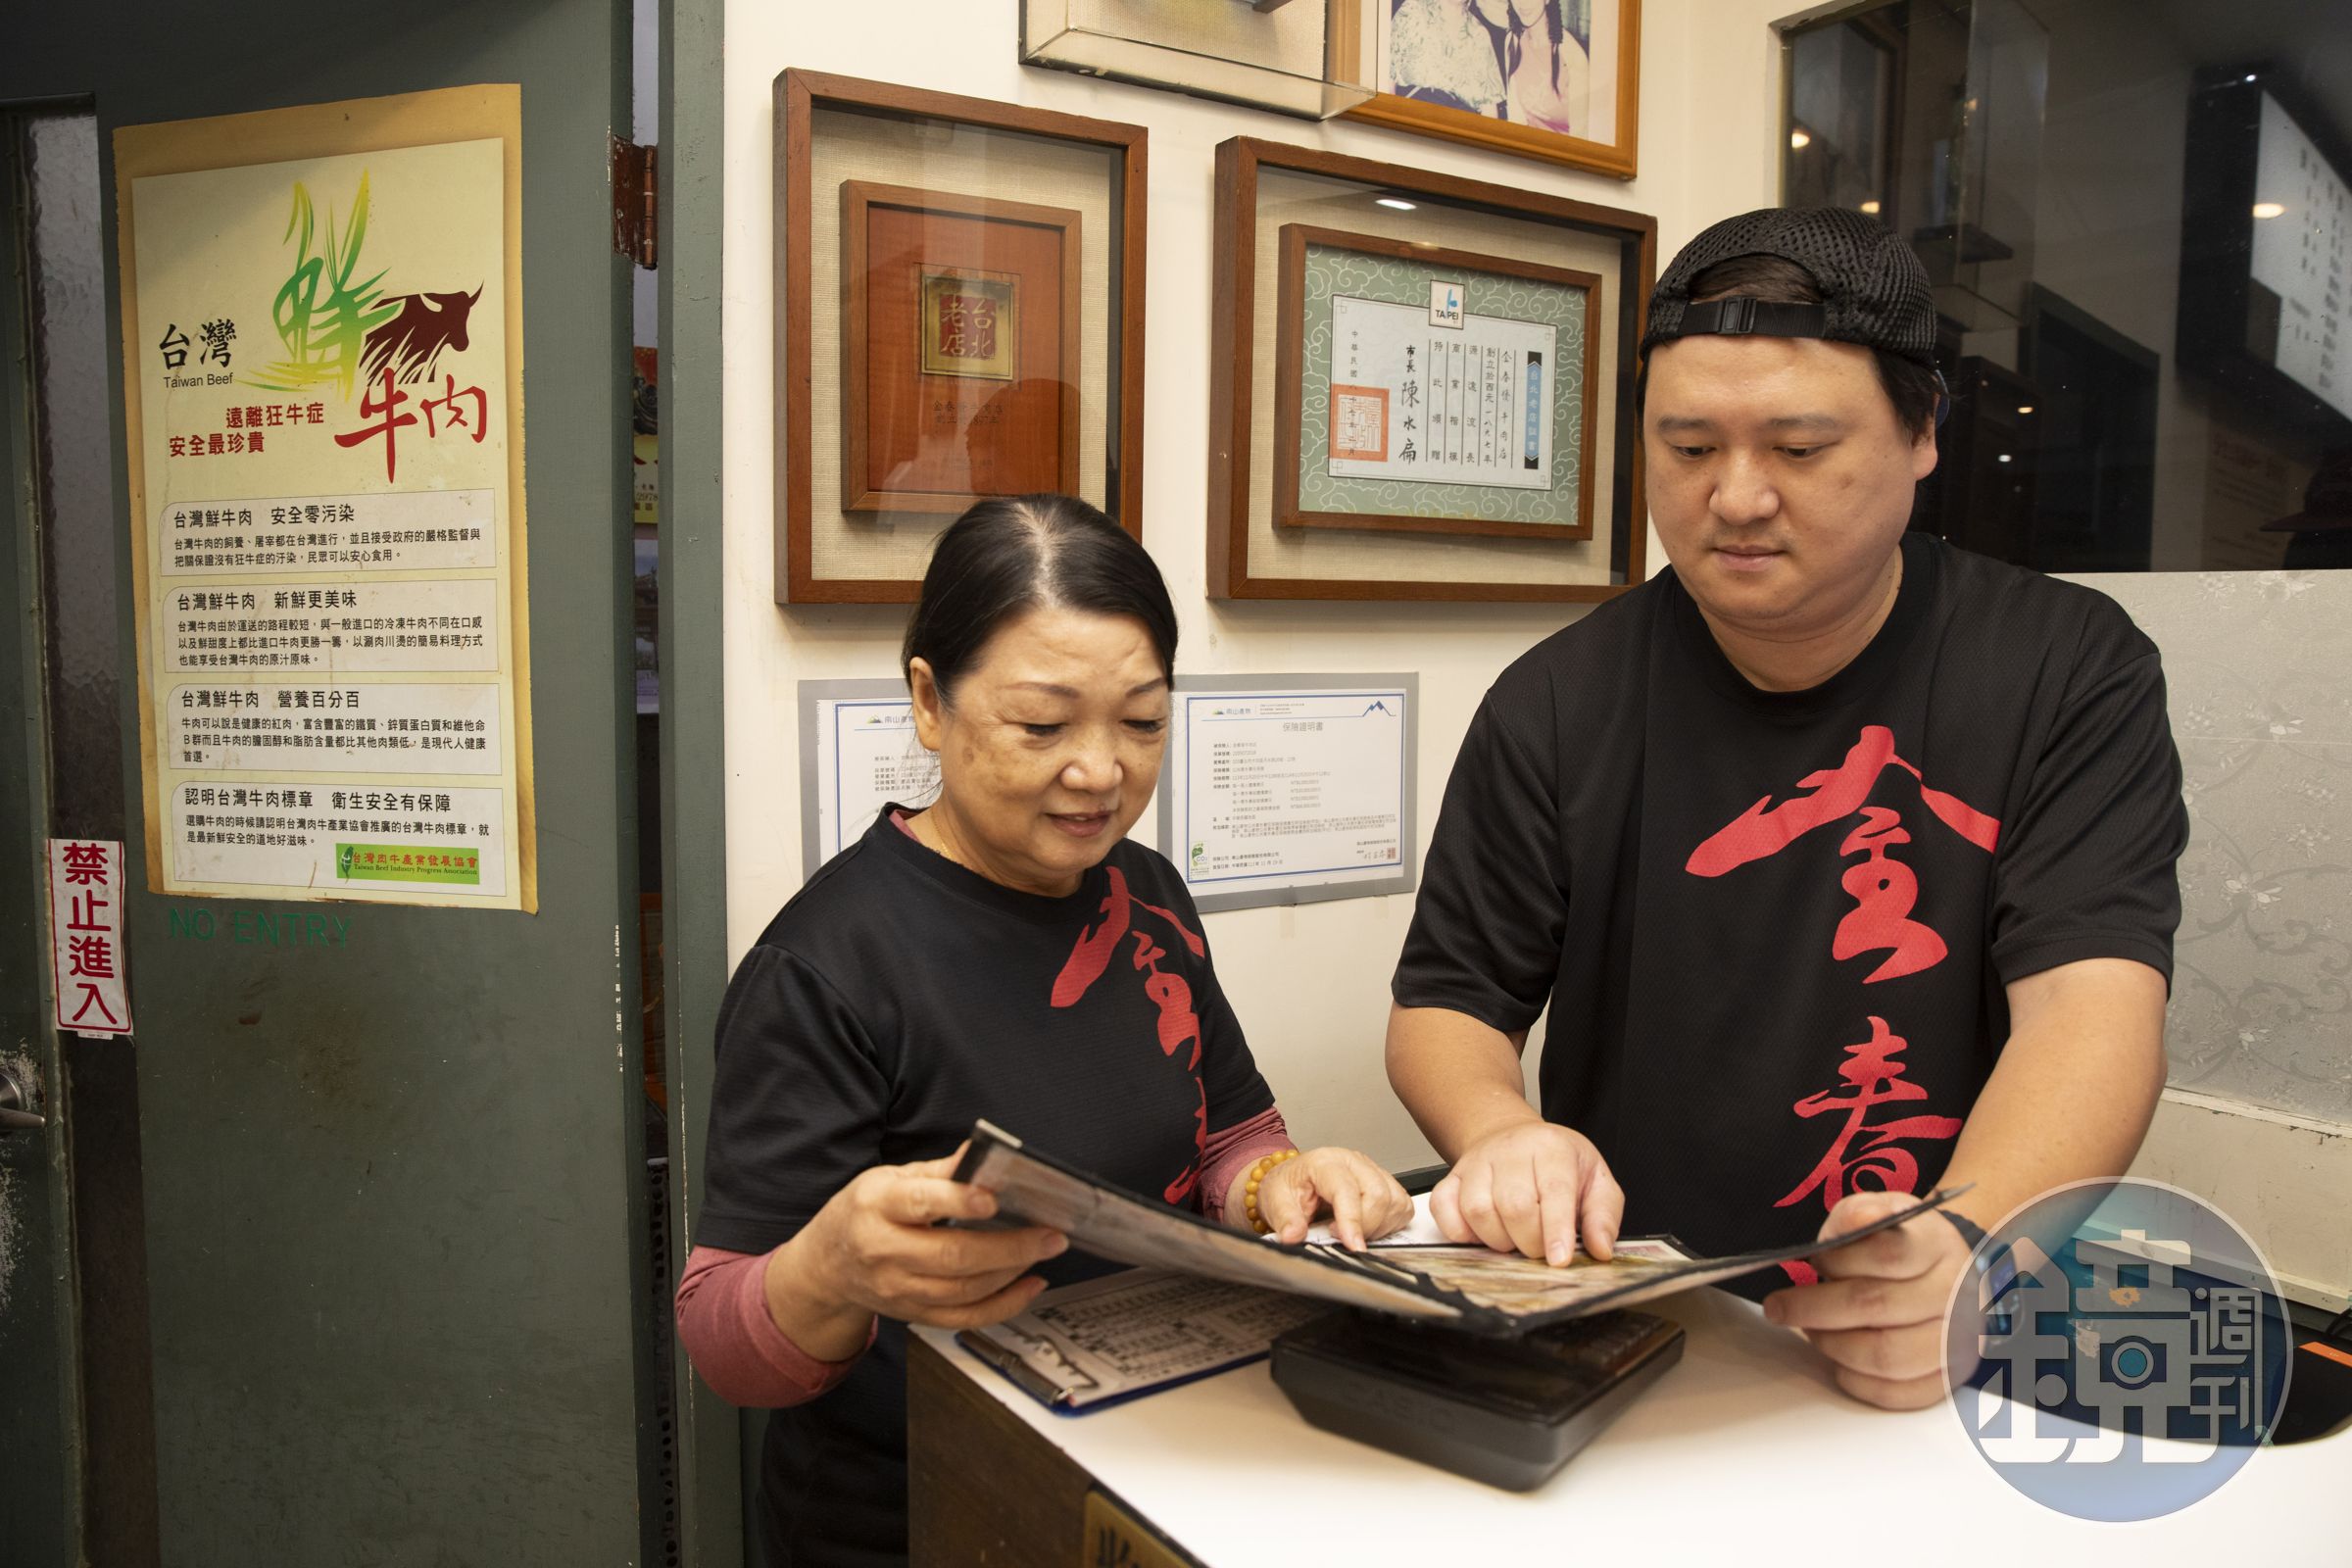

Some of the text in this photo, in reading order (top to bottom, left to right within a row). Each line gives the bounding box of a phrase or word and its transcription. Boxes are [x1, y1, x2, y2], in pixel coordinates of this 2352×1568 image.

[159, 318, 238, 371] 台灣
[164, 372, 234, 389] Taiwan Beef
[224, 402, 324, 429] 遠離狂牛症
[334, 368, 488, 483] 牛肉
[169, 431, 266, 458] 安全最珍貴
[173, 503, 355, 529] 台灣鮮牛肉 安全零污染
[177, 589, 357, 611] 台灣鮮牛肉 新鮮更美味
[178, 653, 318, 666] 也能享受台灣牛肉的原汁原味。
[181, 689, 360, 709] 台灣鮮牛肉 營養百分百
[183, 751, 210, 763] 首選。
[184, 787, 452, 813] 認明台灣牛肉標章 衛生安全有保障
[187, 831, 316, 847] 是最新鮮安全的道地好滋味。
[352, 852, 478, 869] 台灣肉牛產業發展協會
[390, 865, 416, 874] Industry
[416, 866, 442, 875] Progress
[443, 867, 478, 876] Association
[63, 842, 119, 1026] 禁止進入
[169, 907, 352, 949] NO ENTRY
[1684, 723, 2002, 1286] 金春
